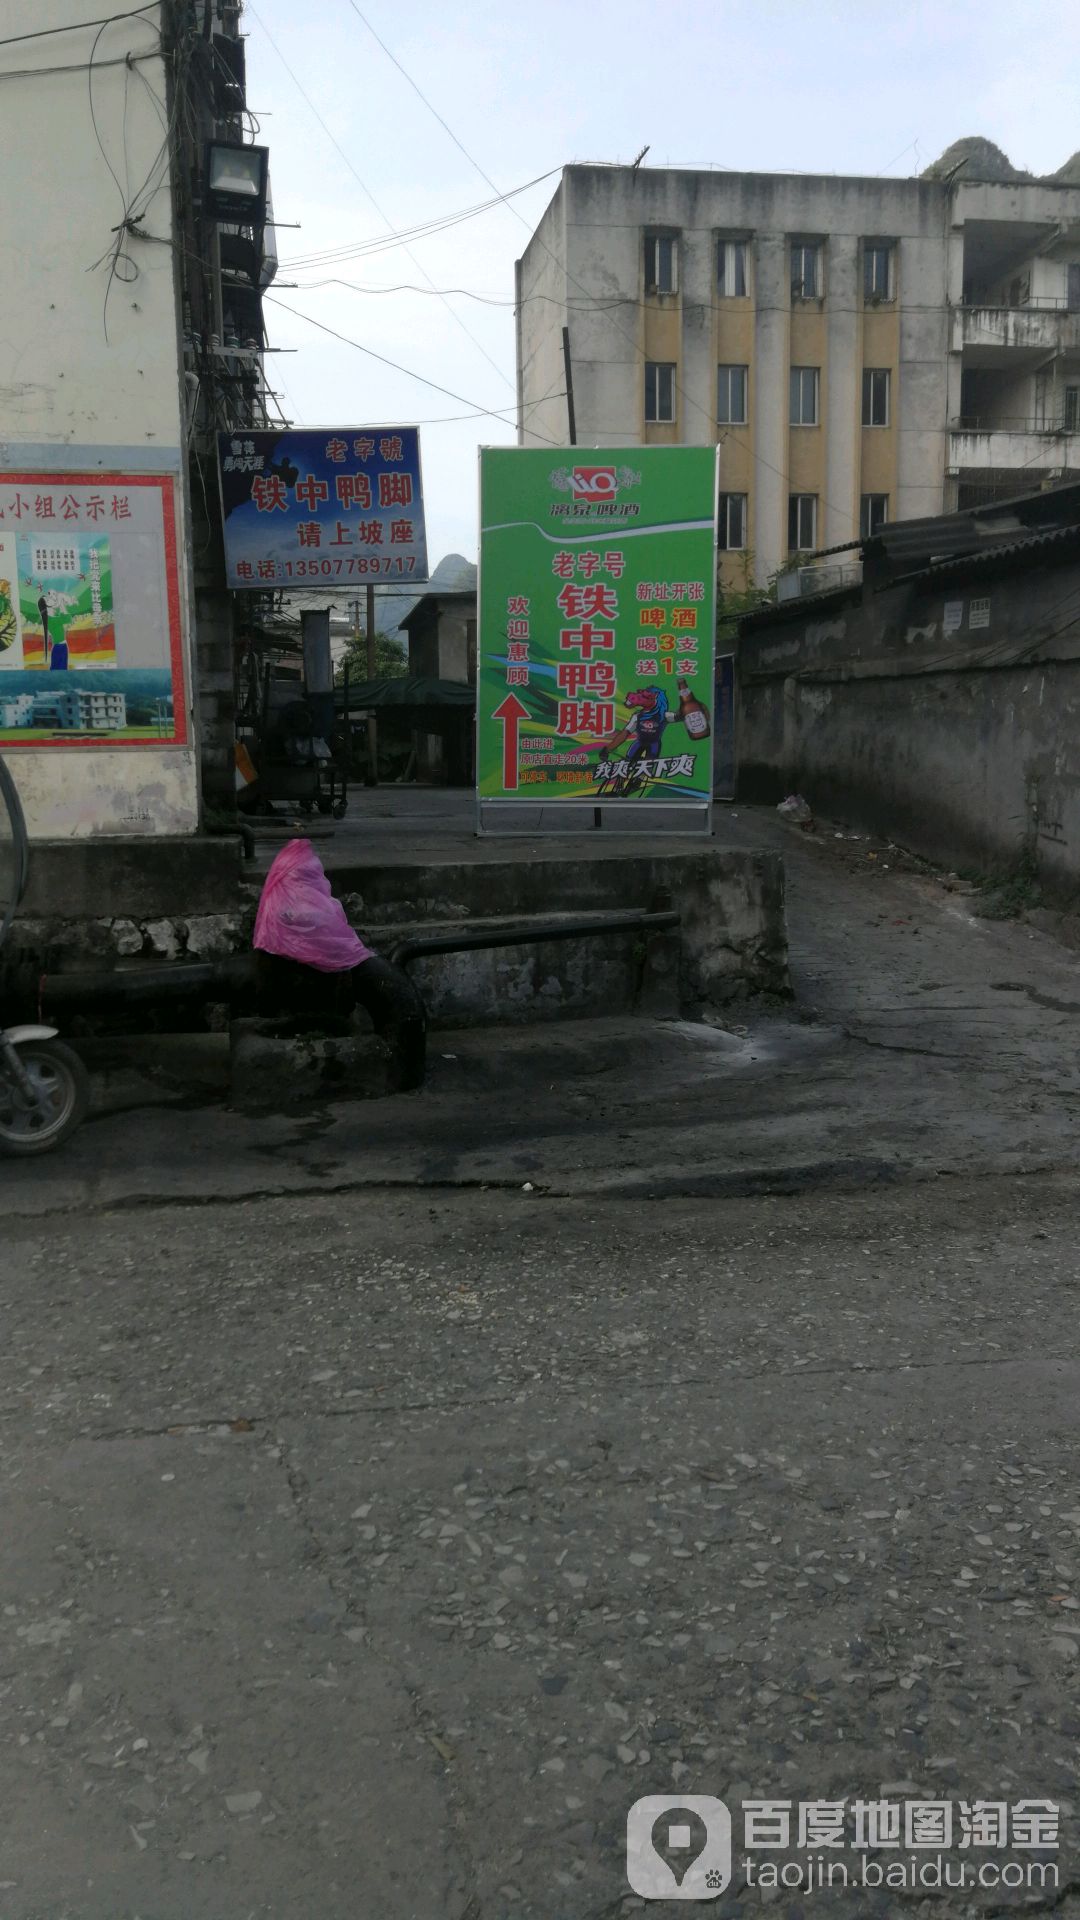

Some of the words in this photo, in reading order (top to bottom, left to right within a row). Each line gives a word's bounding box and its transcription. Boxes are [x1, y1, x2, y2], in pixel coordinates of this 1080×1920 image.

[326, 436, 403, 462] 老字號
[251, 472, 414, 512] 铁中鸭脚
[0, 492, 132, 521] 小组公示栏
[551, 503, 640, 516] 漓泉啤酒
[297, 519, 414, 547] 请上坡座
[236, 556, 416, 580] 电话:13507789717
[552, 551, 625, 578] 老字号
[636, 583, 704, 602] 新址开张
[639, 607, 697, 628] 啤酒
[506, 596, 530, 686] 欢迎惠顾
[636, 634, 698, 652] 喝3支
[556, 583, 618, 737] 铁中鸭脚
[636, 658, 698, 676] 送1支
[521, 737, 554, 750] 由此进
[520, 753, 588, 765] 原店直走20米
